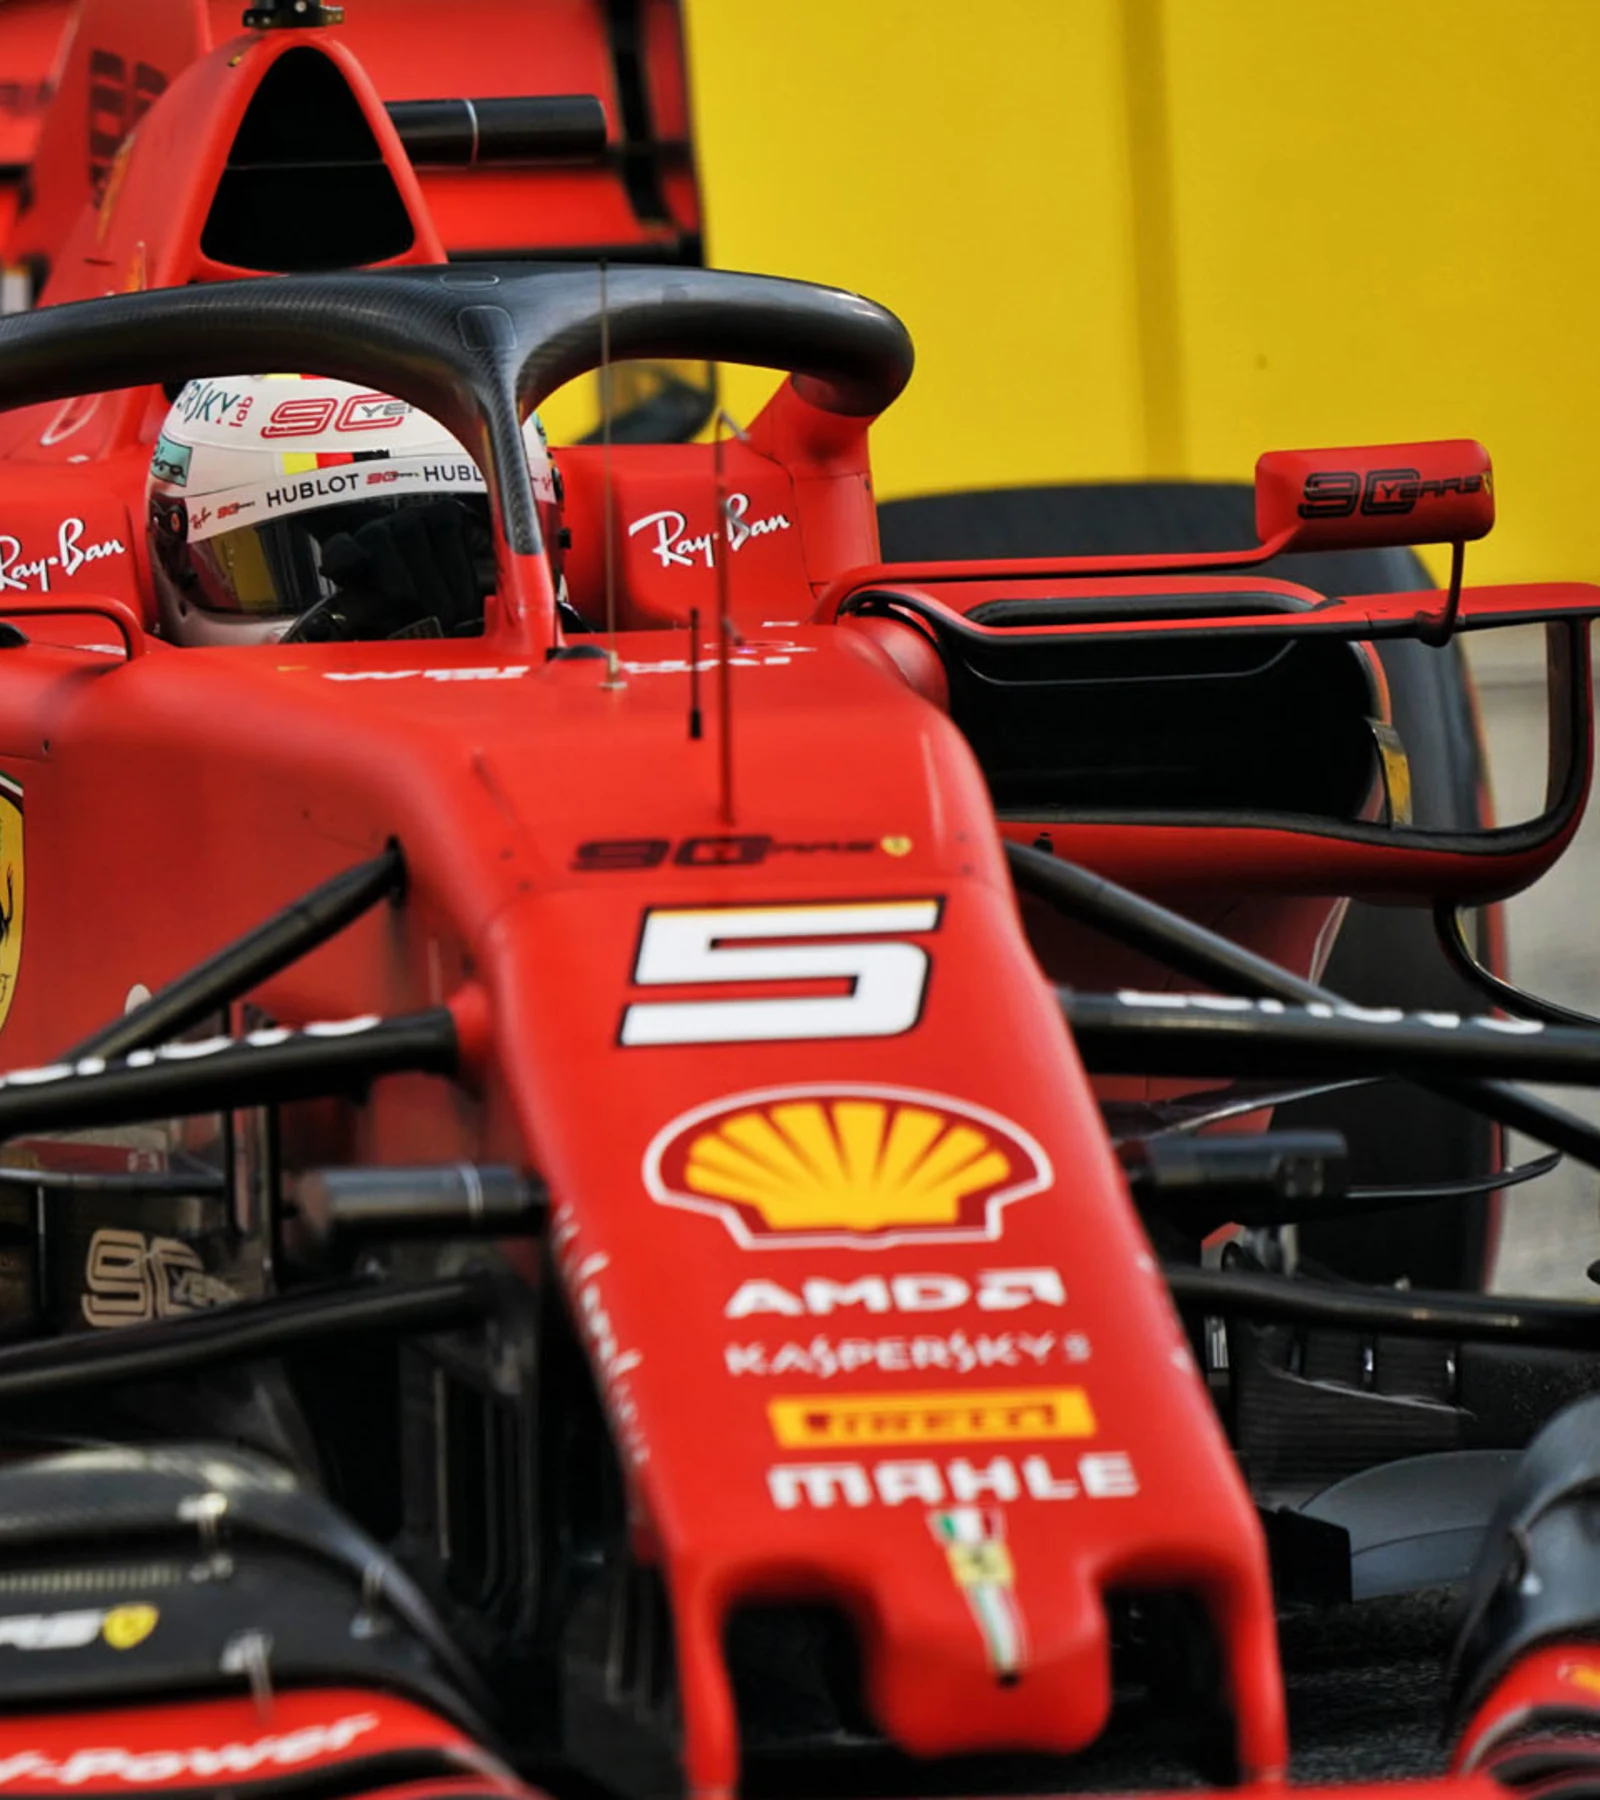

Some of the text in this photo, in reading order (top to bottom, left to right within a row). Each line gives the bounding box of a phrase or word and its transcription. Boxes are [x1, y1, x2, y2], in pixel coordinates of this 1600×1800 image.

[265, 473, 360, 508] HUBLOT
[1379, 474, 1483, 500] YEARS
[628, 493, 791, 568] Ray-Ban
[614, 896, 946, 1048] 5
[723, 1332, 1056, 1379] KASPERSKY
[766, 1452, 1140, 1510] MAHLE
